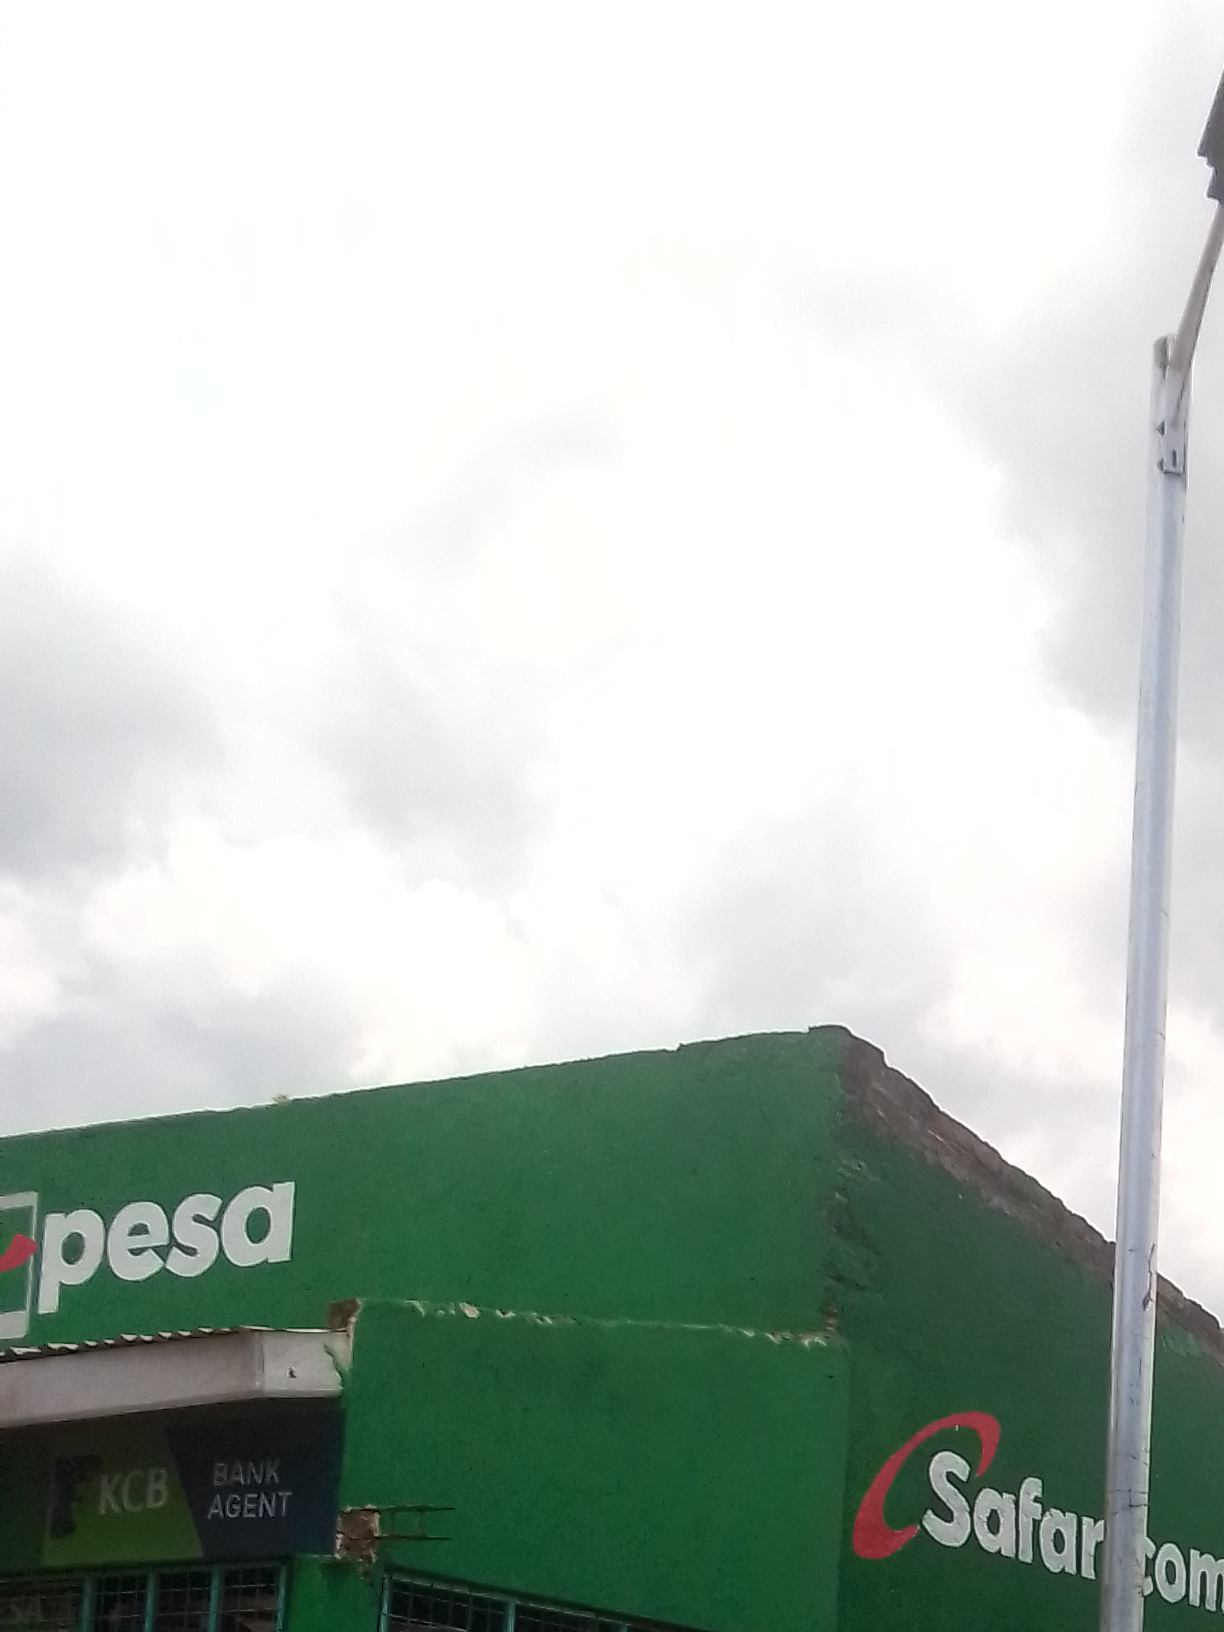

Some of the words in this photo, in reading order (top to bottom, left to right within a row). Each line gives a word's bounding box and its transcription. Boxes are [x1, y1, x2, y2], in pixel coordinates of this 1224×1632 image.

[213, 1459, 282, 1487] BANK
[99, 1467, 170, 1515] KCB
[207, 1491, 293, 1519] AGENT
